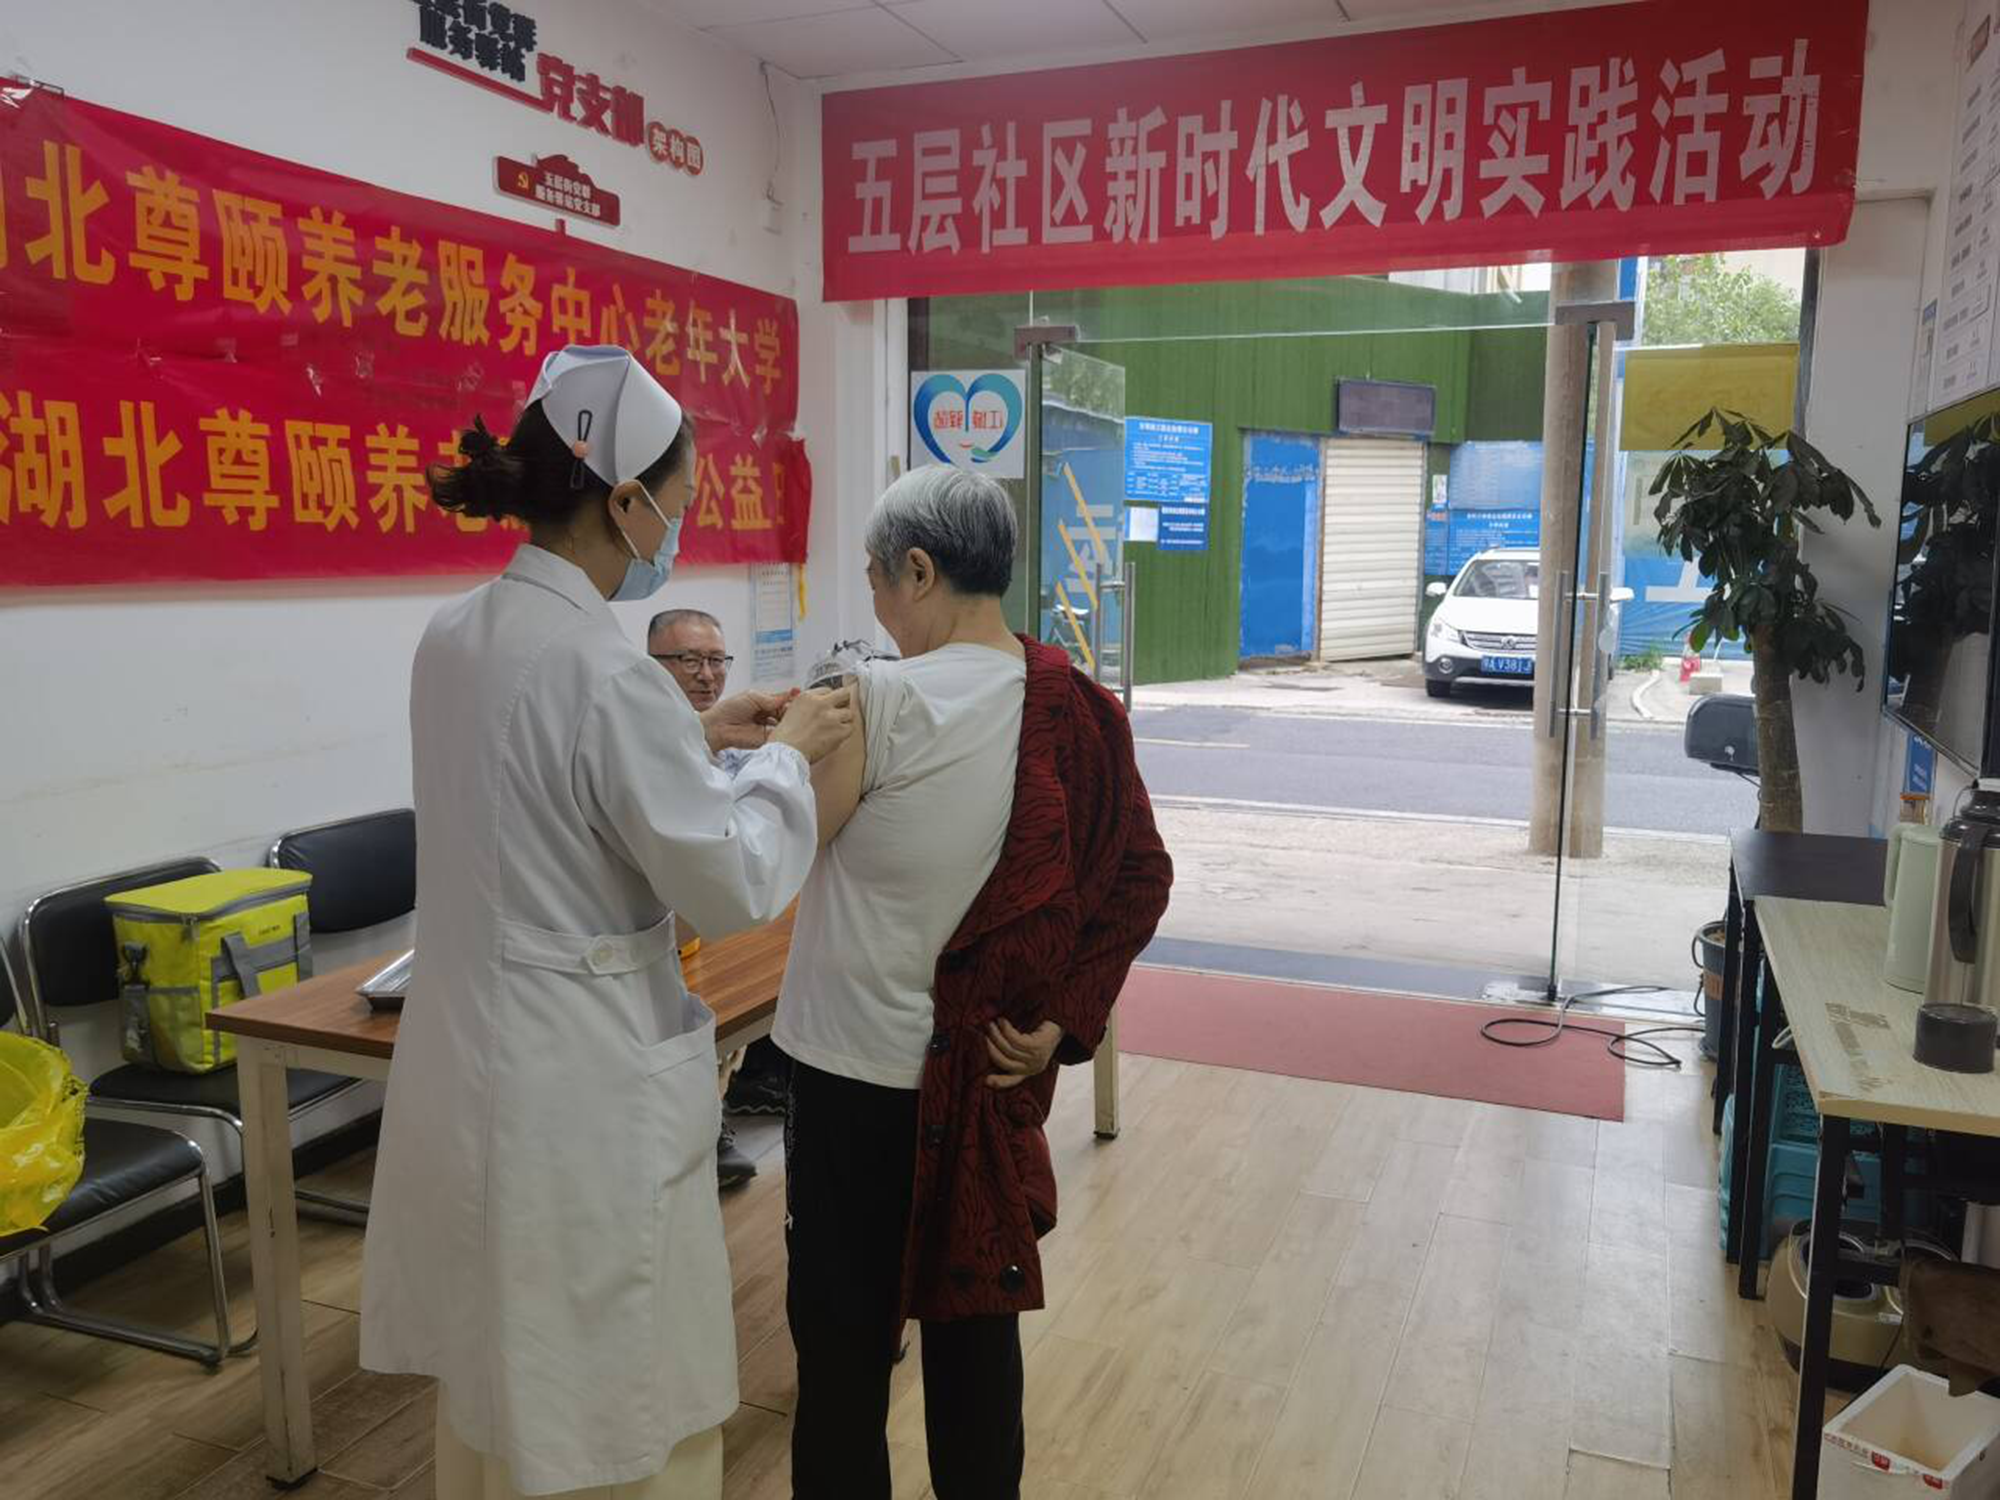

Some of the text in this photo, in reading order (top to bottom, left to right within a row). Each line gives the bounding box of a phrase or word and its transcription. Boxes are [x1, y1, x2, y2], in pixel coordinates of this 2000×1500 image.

[537, 52, 645, 146] 党支部
[848, 38, 1821, 256] 五层社区新时代文明实践活动
[0, 139, 783, 395] 北尊颐养老服务中心老年大学
